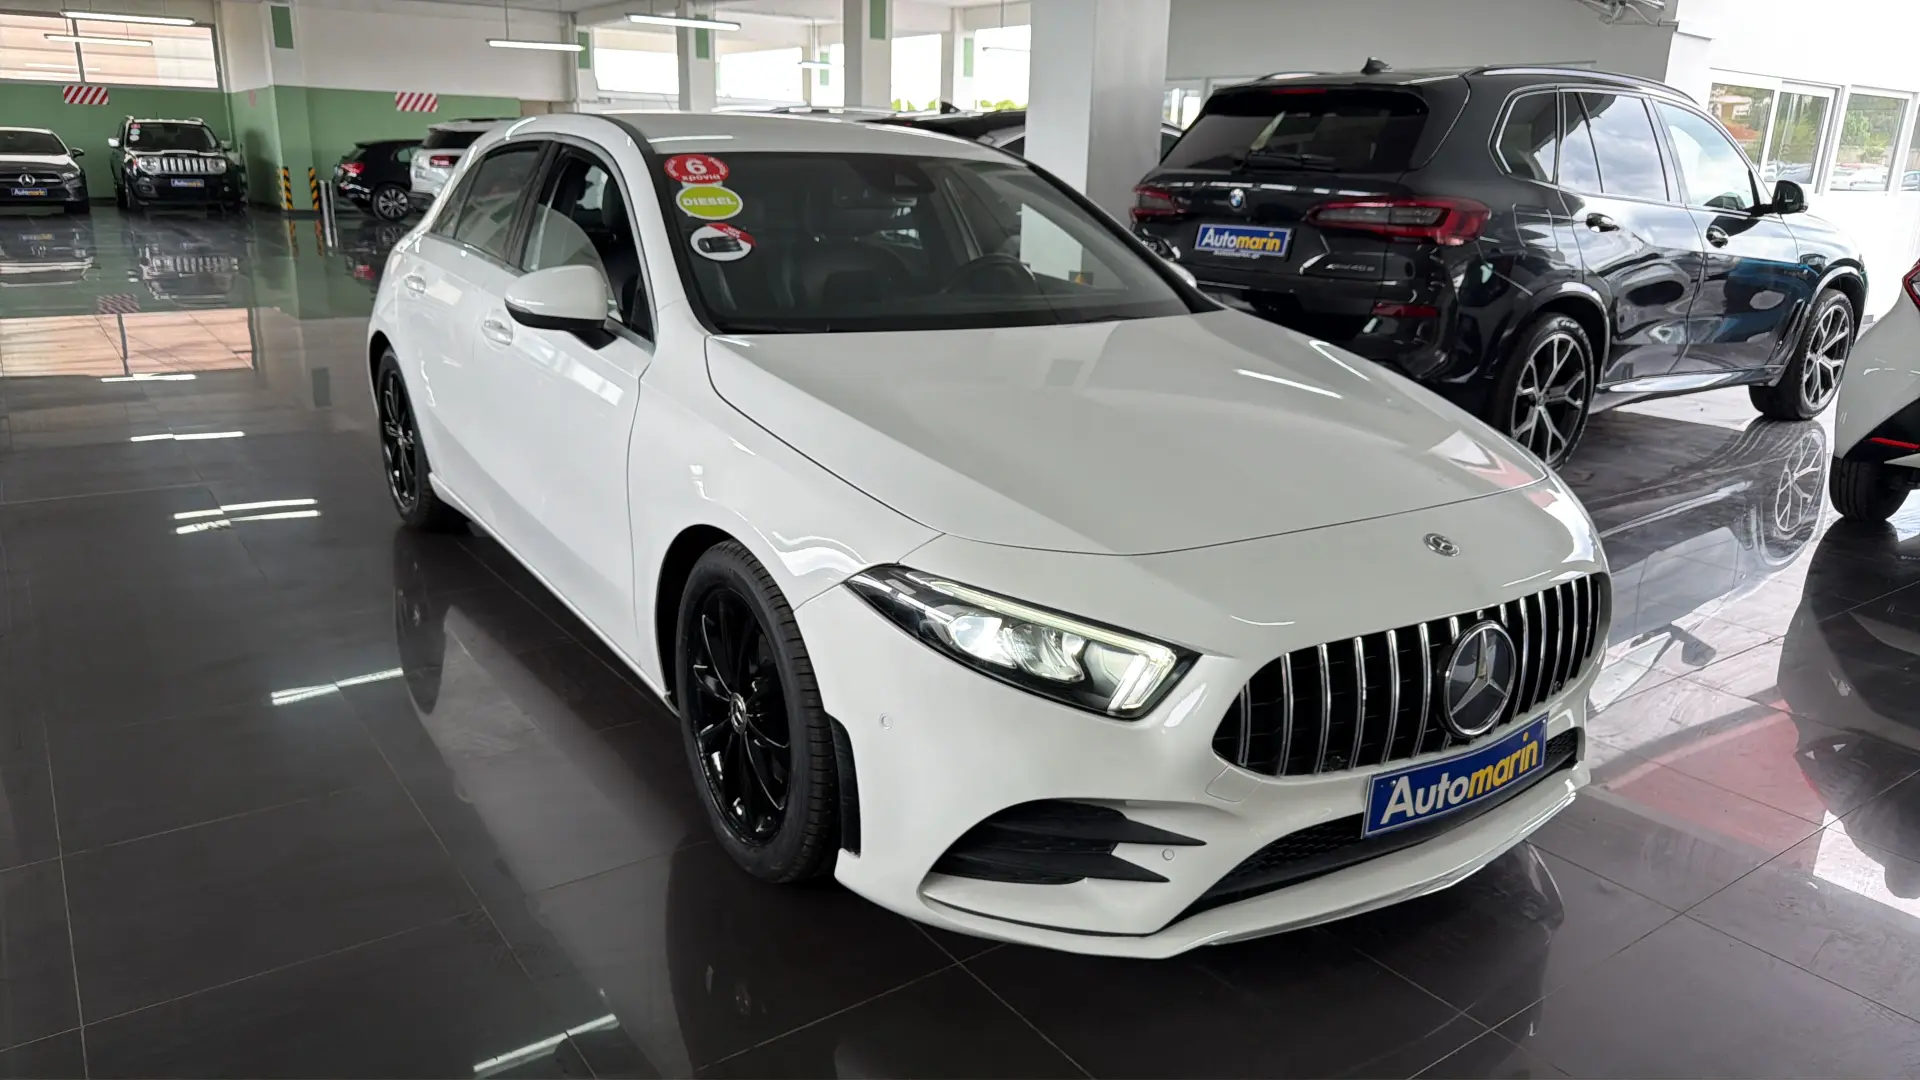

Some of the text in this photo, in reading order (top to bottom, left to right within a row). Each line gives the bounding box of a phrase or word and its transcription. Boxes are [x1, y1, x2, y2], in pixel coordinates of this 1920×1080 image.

[685, 158, 707, 175] 6
[682, 197, 737, 206] DIESEL
[1201, 228, 1280, 251] Automarin
[1380, 731, 1539, 825] Automarin
